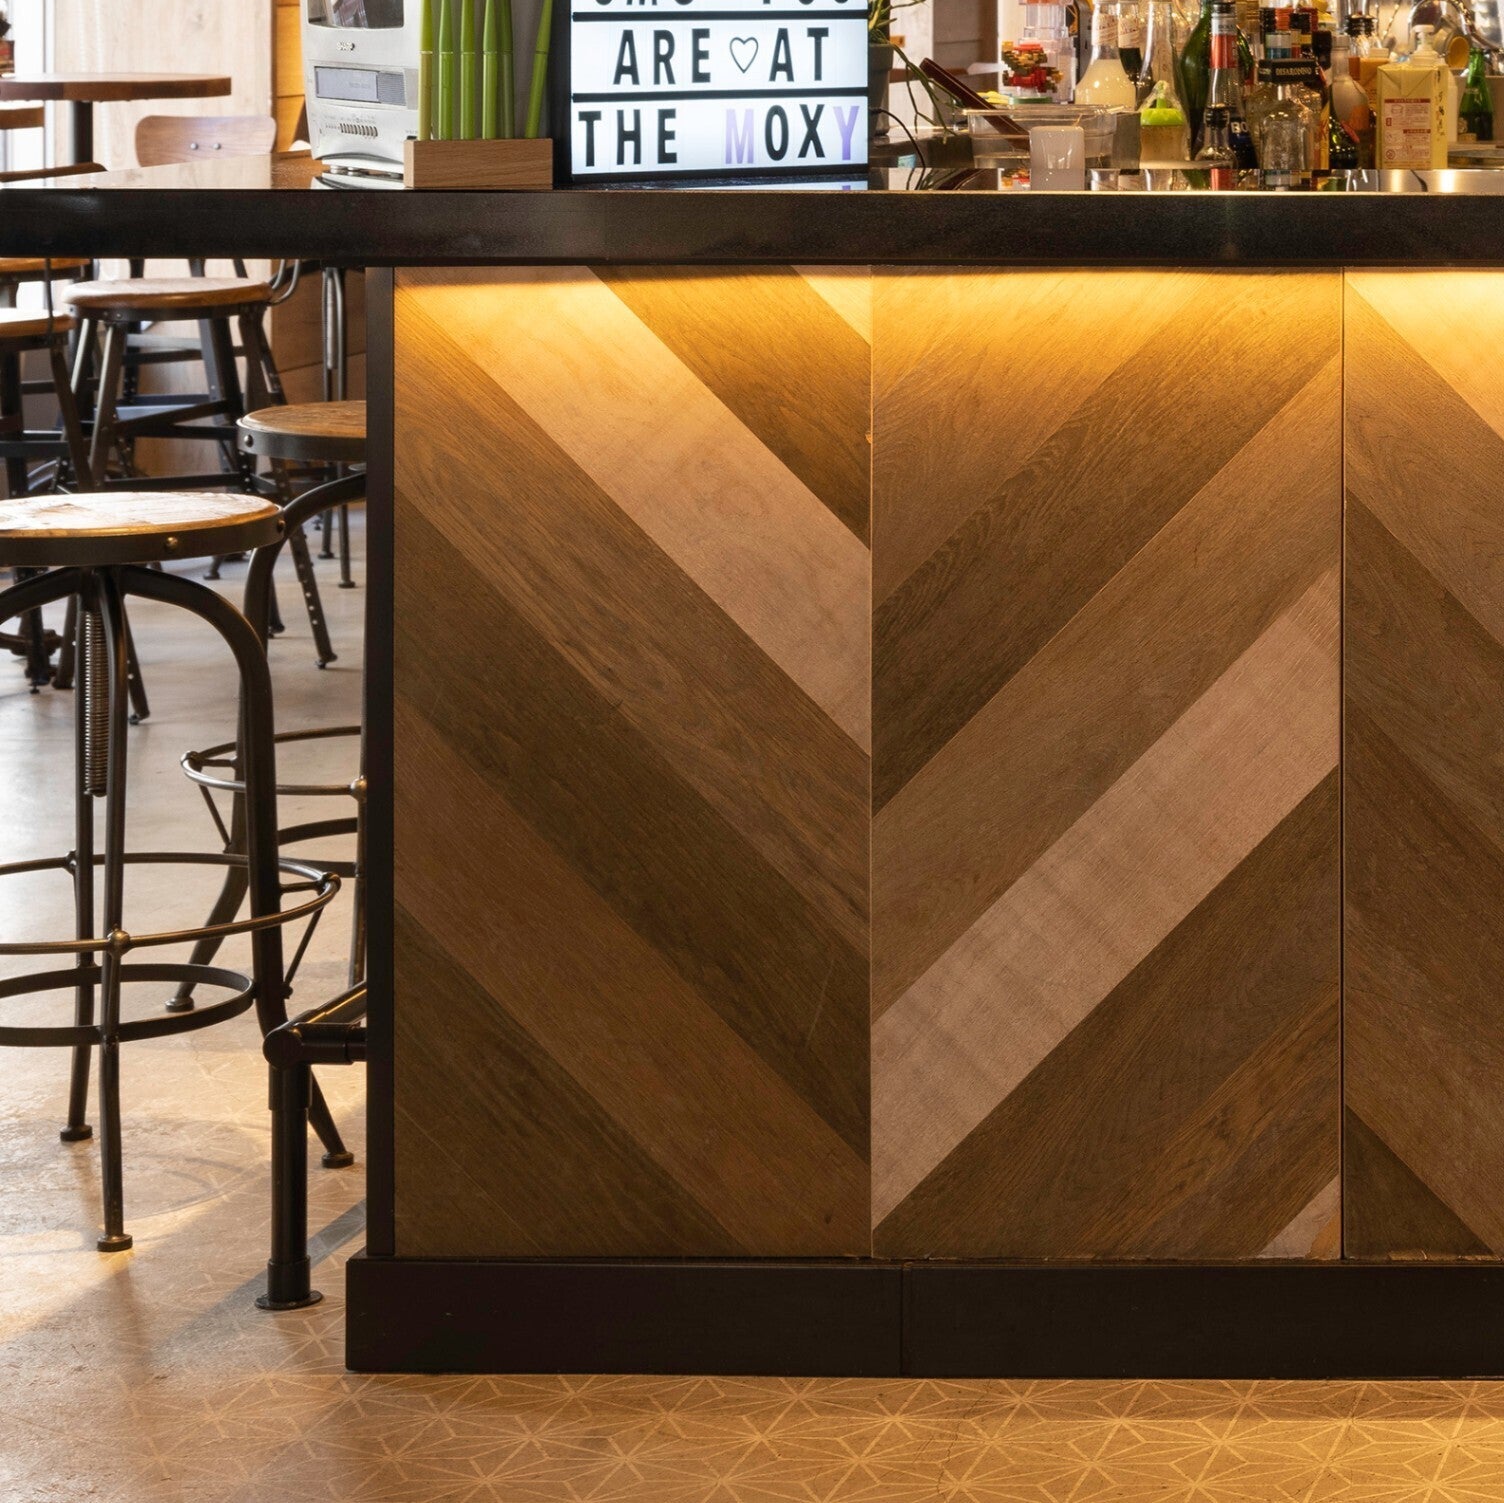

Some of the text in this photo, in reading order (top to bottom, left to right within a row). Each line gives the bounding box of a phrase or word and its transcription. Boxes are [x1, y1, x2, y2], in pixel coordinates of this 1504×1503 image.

[613, 26, 830, 86] ARE AT
[578, 104, 858, 167] THE MOXY
